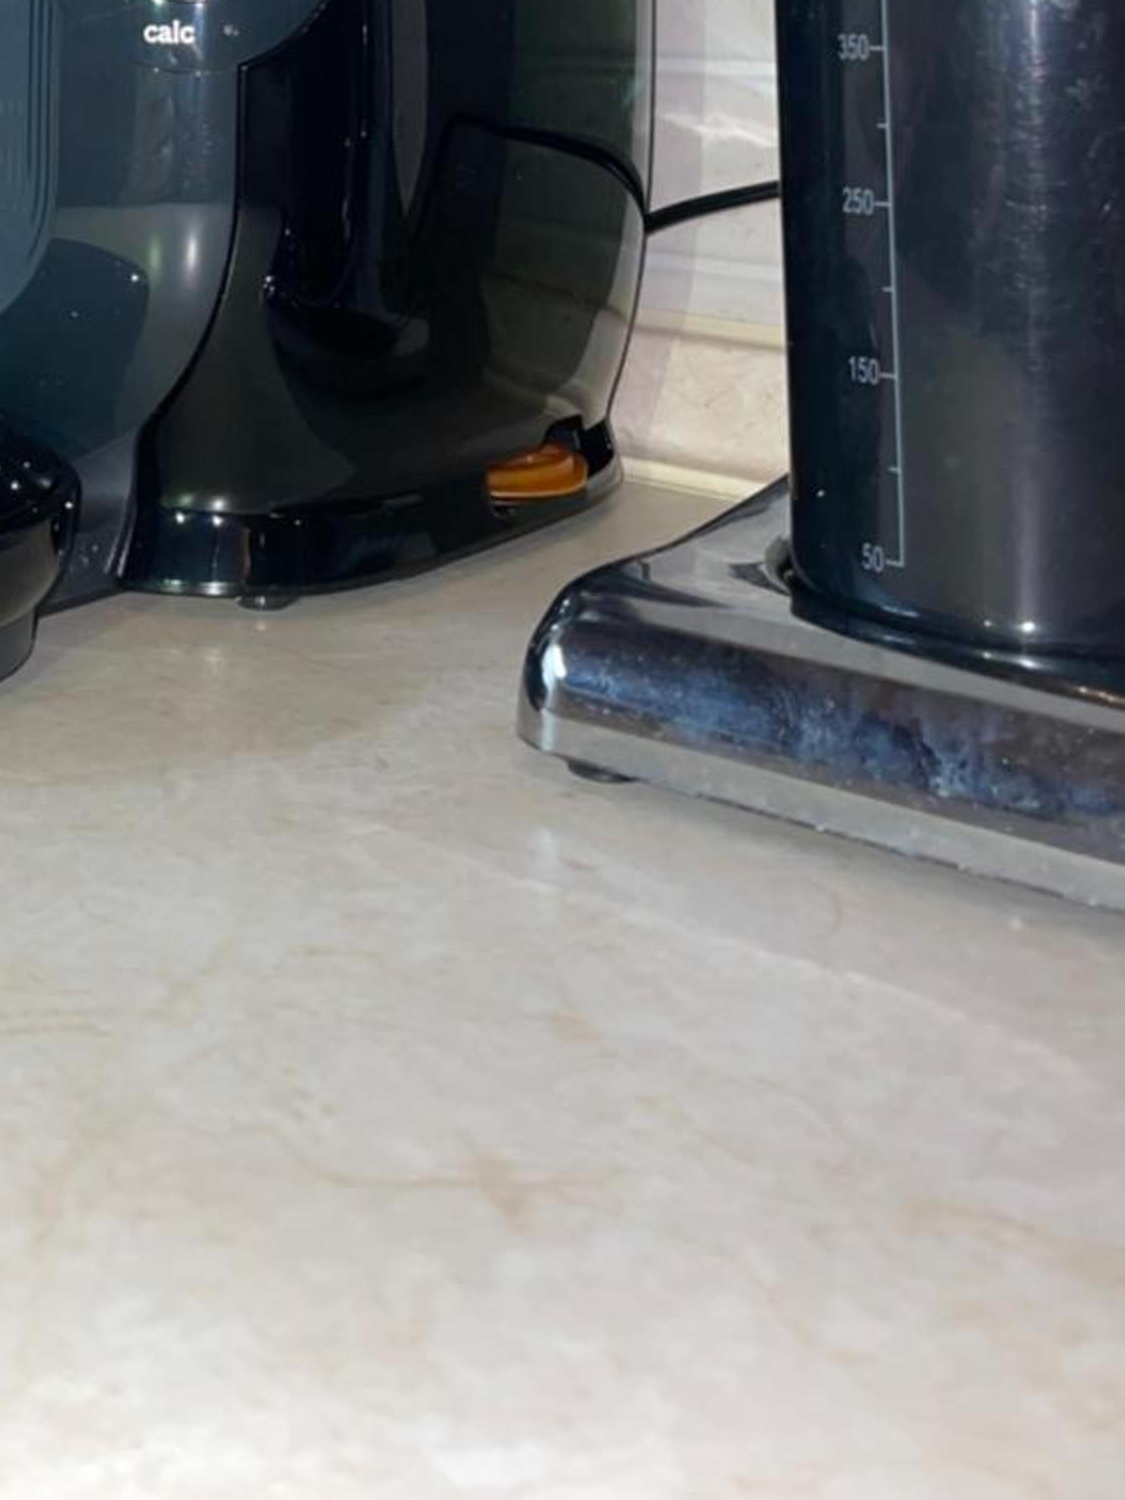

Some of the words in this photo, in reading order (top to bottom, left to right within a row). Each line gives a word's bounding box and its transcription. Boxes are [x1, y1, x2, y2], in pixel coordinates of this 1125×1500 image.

[143, 20, 195, 44] calc
[837, 33, 869, 60] 350
[843, 188, 874, 215] 250
[848, 356, 881, 385] 150
[862, 544, 883, 571] 50
